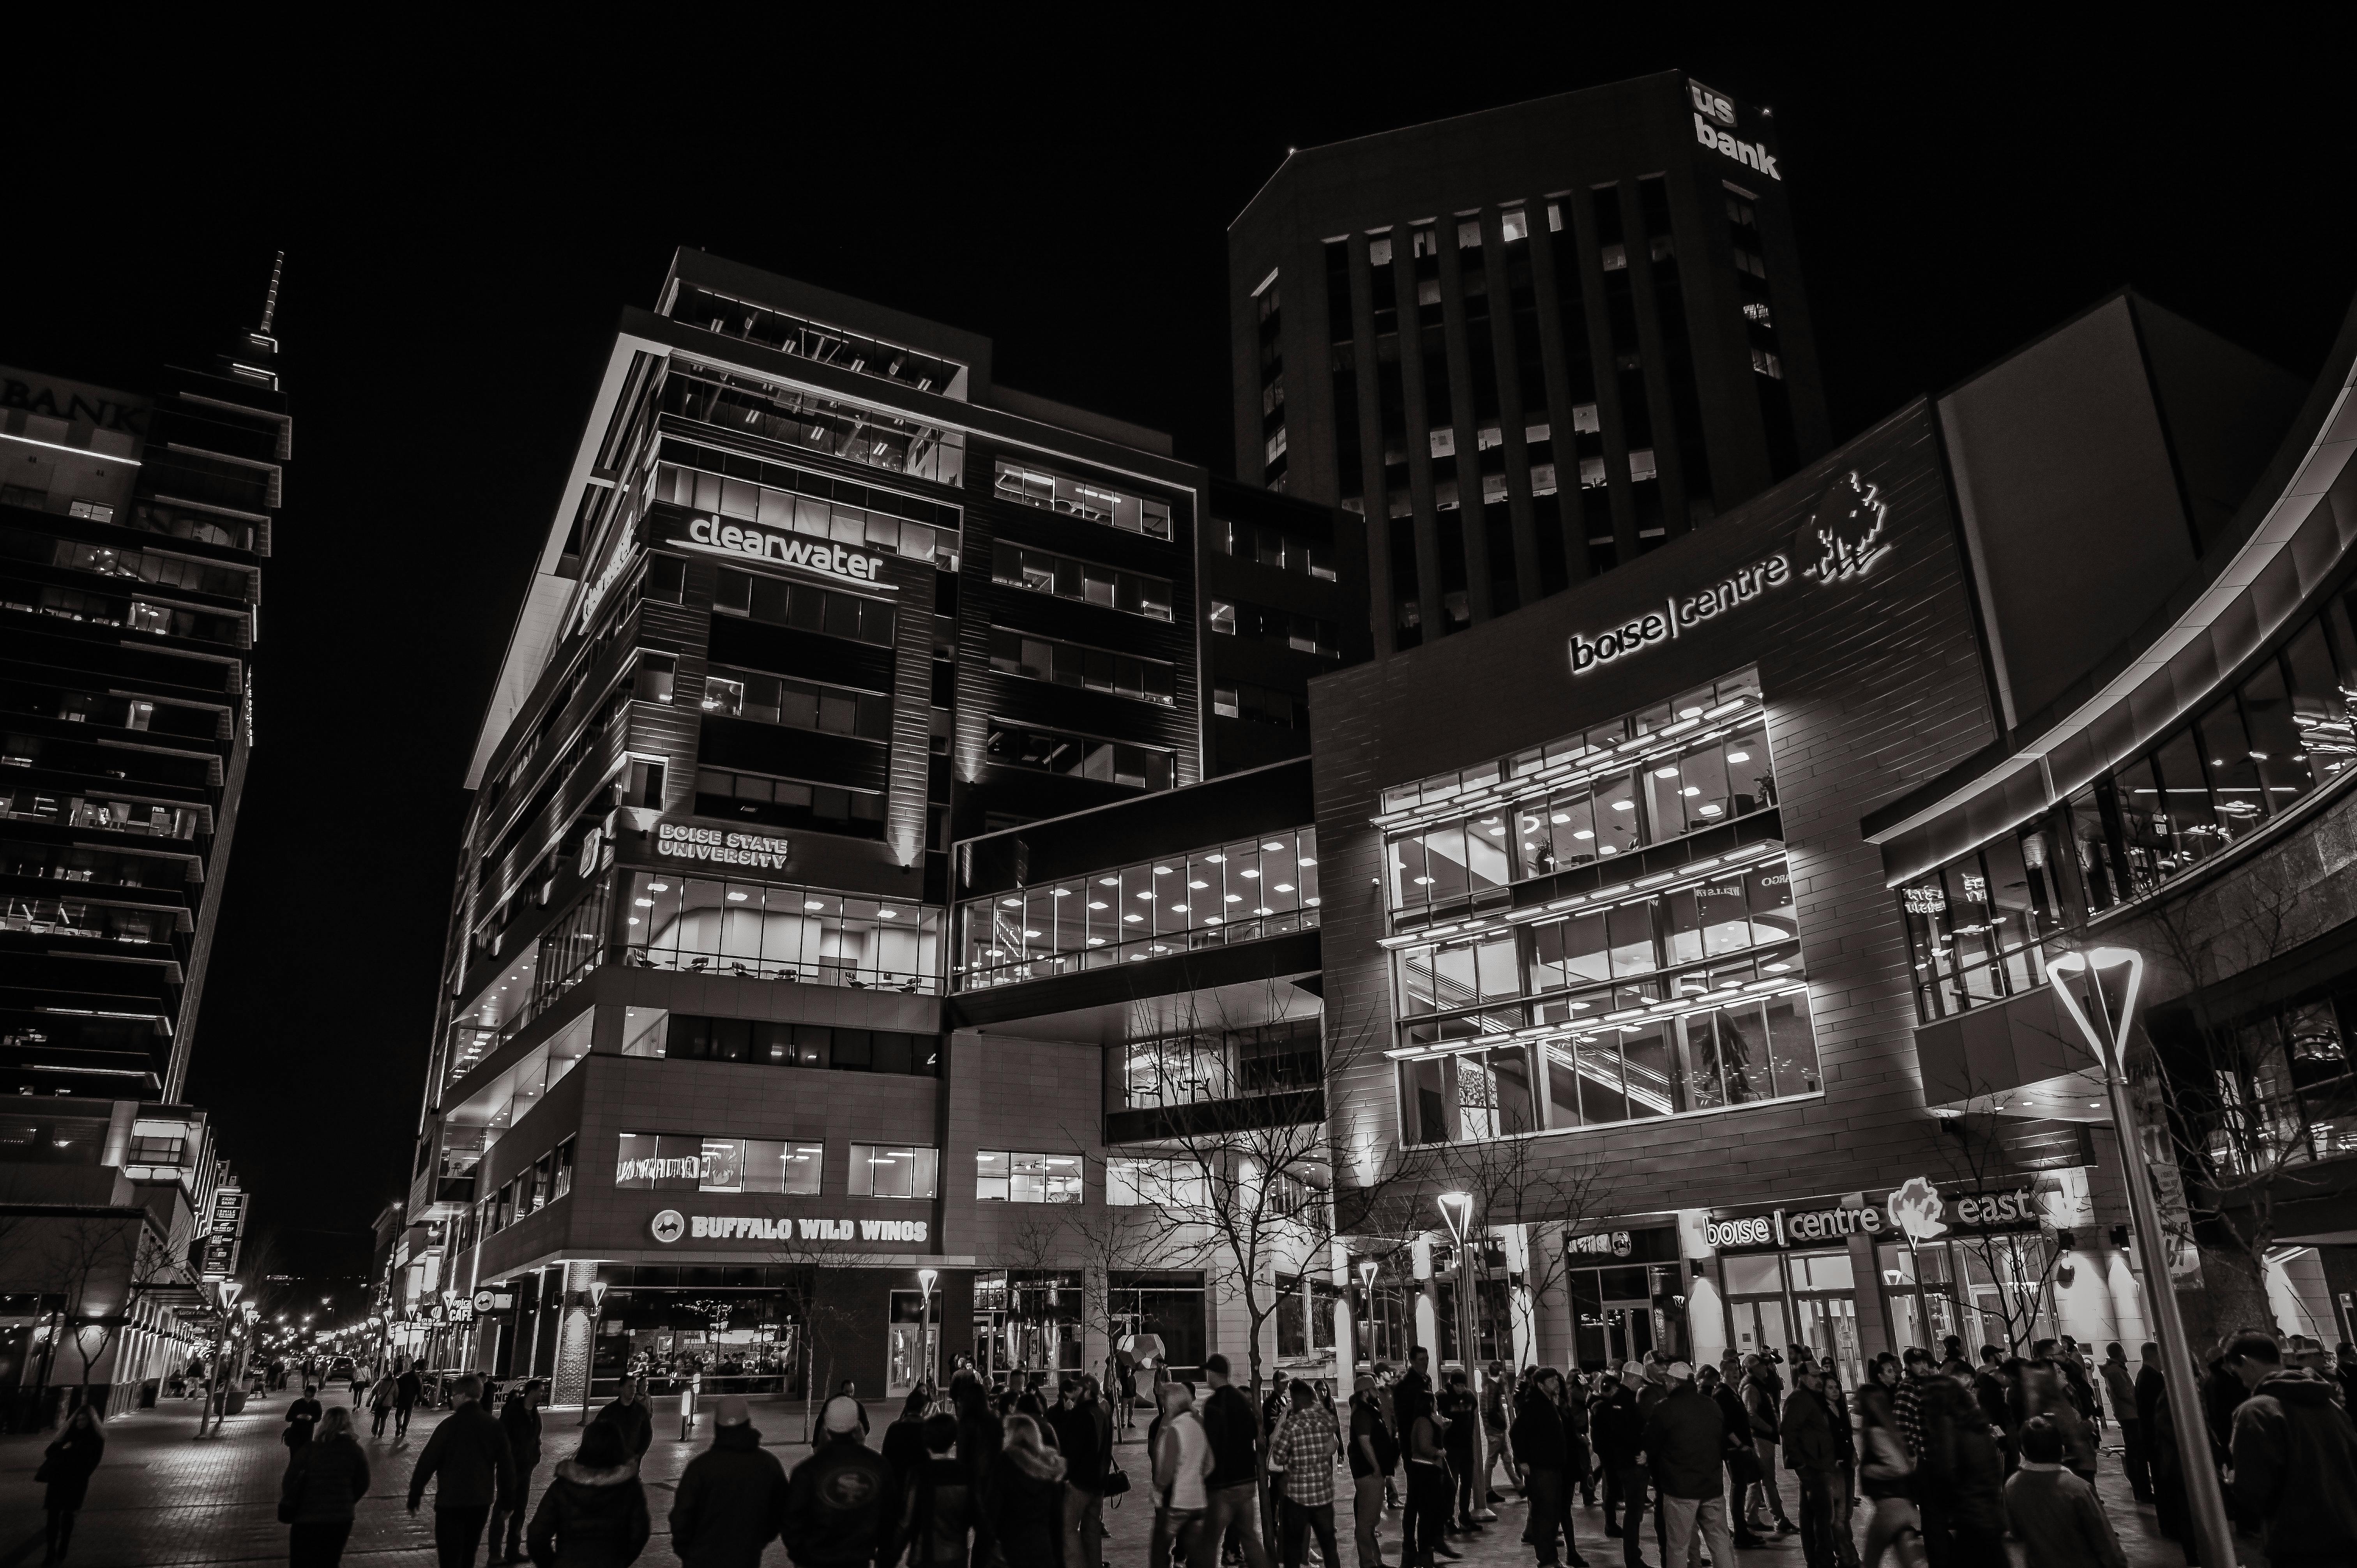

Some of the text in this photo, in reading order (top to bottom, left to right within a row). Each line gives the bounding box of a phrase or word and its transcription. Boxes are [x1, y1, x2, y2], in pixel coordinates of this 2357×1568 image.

[1692, 86, 1734, 124] us
[1694, 112, 1781, 181] bank
[0, 379, 146, 436] BANK
[689, 515, 883, 580] clearwater
[1569, 555, 1790, 674] boise centre
[658, 840, 787, 869] UNIVERSITY
[659, 824, 788, 854] BOISE STATE
[692, 1216, 927, 1242] BUFFALO WILD WINGS
[1702, 1189, 2033, 1247] boise centre east
[449, 1309, 473, 1321] CAFE
